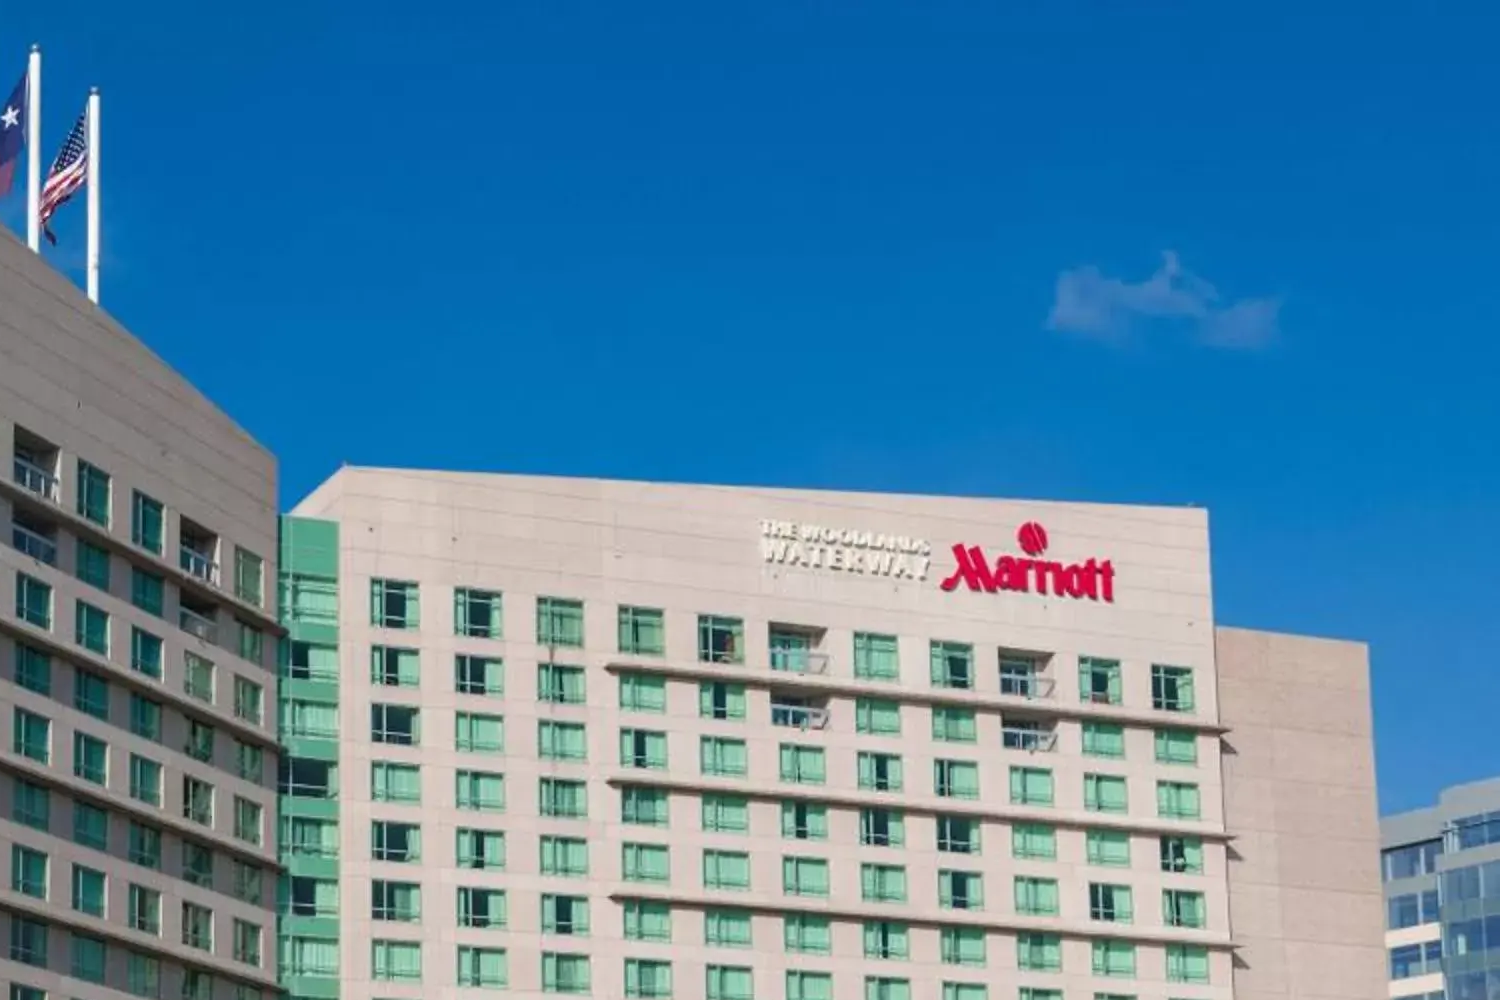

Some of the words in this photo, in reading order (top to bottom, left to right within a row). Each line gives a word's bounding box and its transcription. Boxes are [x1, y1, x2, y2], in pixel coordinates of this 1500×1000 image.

[760, 520, 798, 540] THE
[762, 539, 930, 580] WATERWAY
[940, 522, 1115, 602] Marriott
